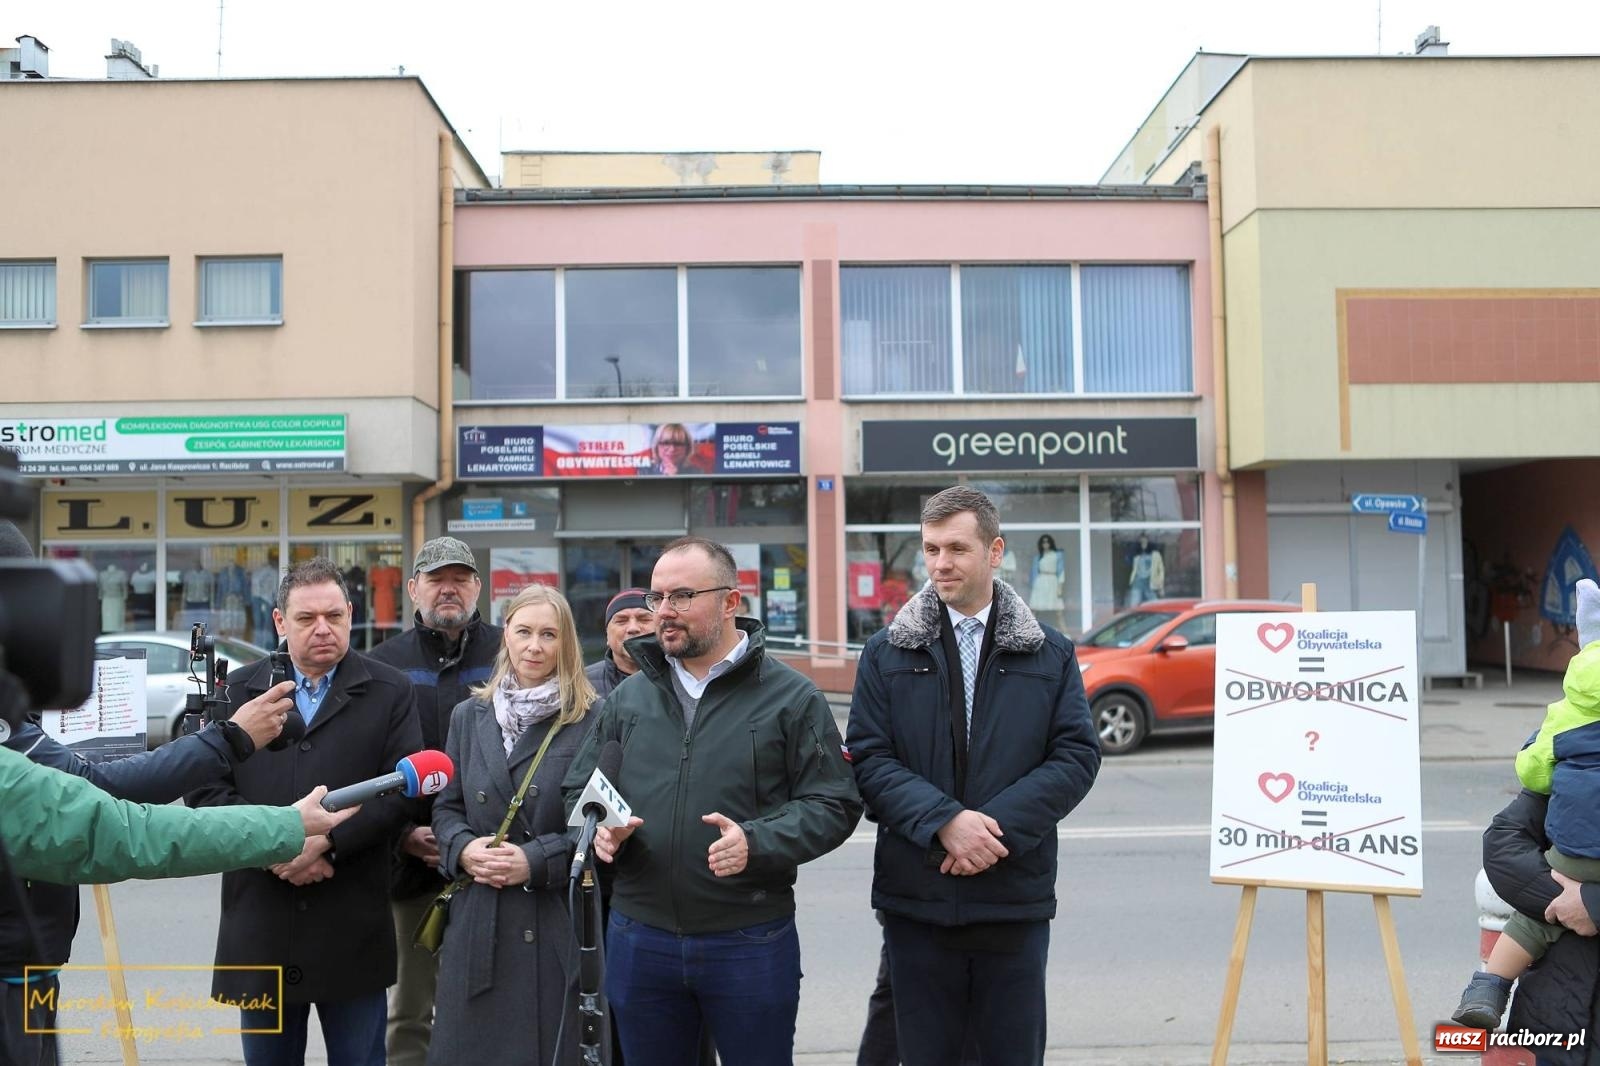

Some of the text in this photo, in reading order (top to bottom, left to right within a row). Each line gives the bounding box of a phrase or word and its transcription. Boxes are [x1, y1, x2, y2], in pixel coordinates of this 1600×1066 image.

[121, 419, 343, 430] KOMPLEKSOWA DIAGNOSTYKA USG COLOR DOPPLER
[193, 438, 340, 450] ZESPÓŁ GABINETÓW LEKARSKICH
[503, 437, 535, 446] BIURO
[722, 434, 755, 443] BIURO
[44, 443, 107, 455] MEDYCZNE
[480, 445, 535, 454] POSELSKIE
[578, 441, 625, 451] STREFA
[722, 442, 777, 451] POSELSKIE
[932, 424, 1129, 466] greenpoint
[497, 455, 535, 463] GABRIELI
[556, 456, 651, 469] OBYWATELSKA
[723, 459, 792, 469] LENARTOWICZ
[467, 463, 535, 473] LENARTOWICZ
[1297, 629, 1348, 641] Koalicja
[1297, 639, 1382, 652] Obywatelska
[1225, 680, 1408, 703] OBWODNICA
[1298, 780, 1348, 794] Koalicja
[1297, 790, 1382, 804] Obywatelska
[1218, 826, 1248, 847] 30
[1310, 831, 1351, 852] dla
[1358, 833, 1419, 857] ANS
